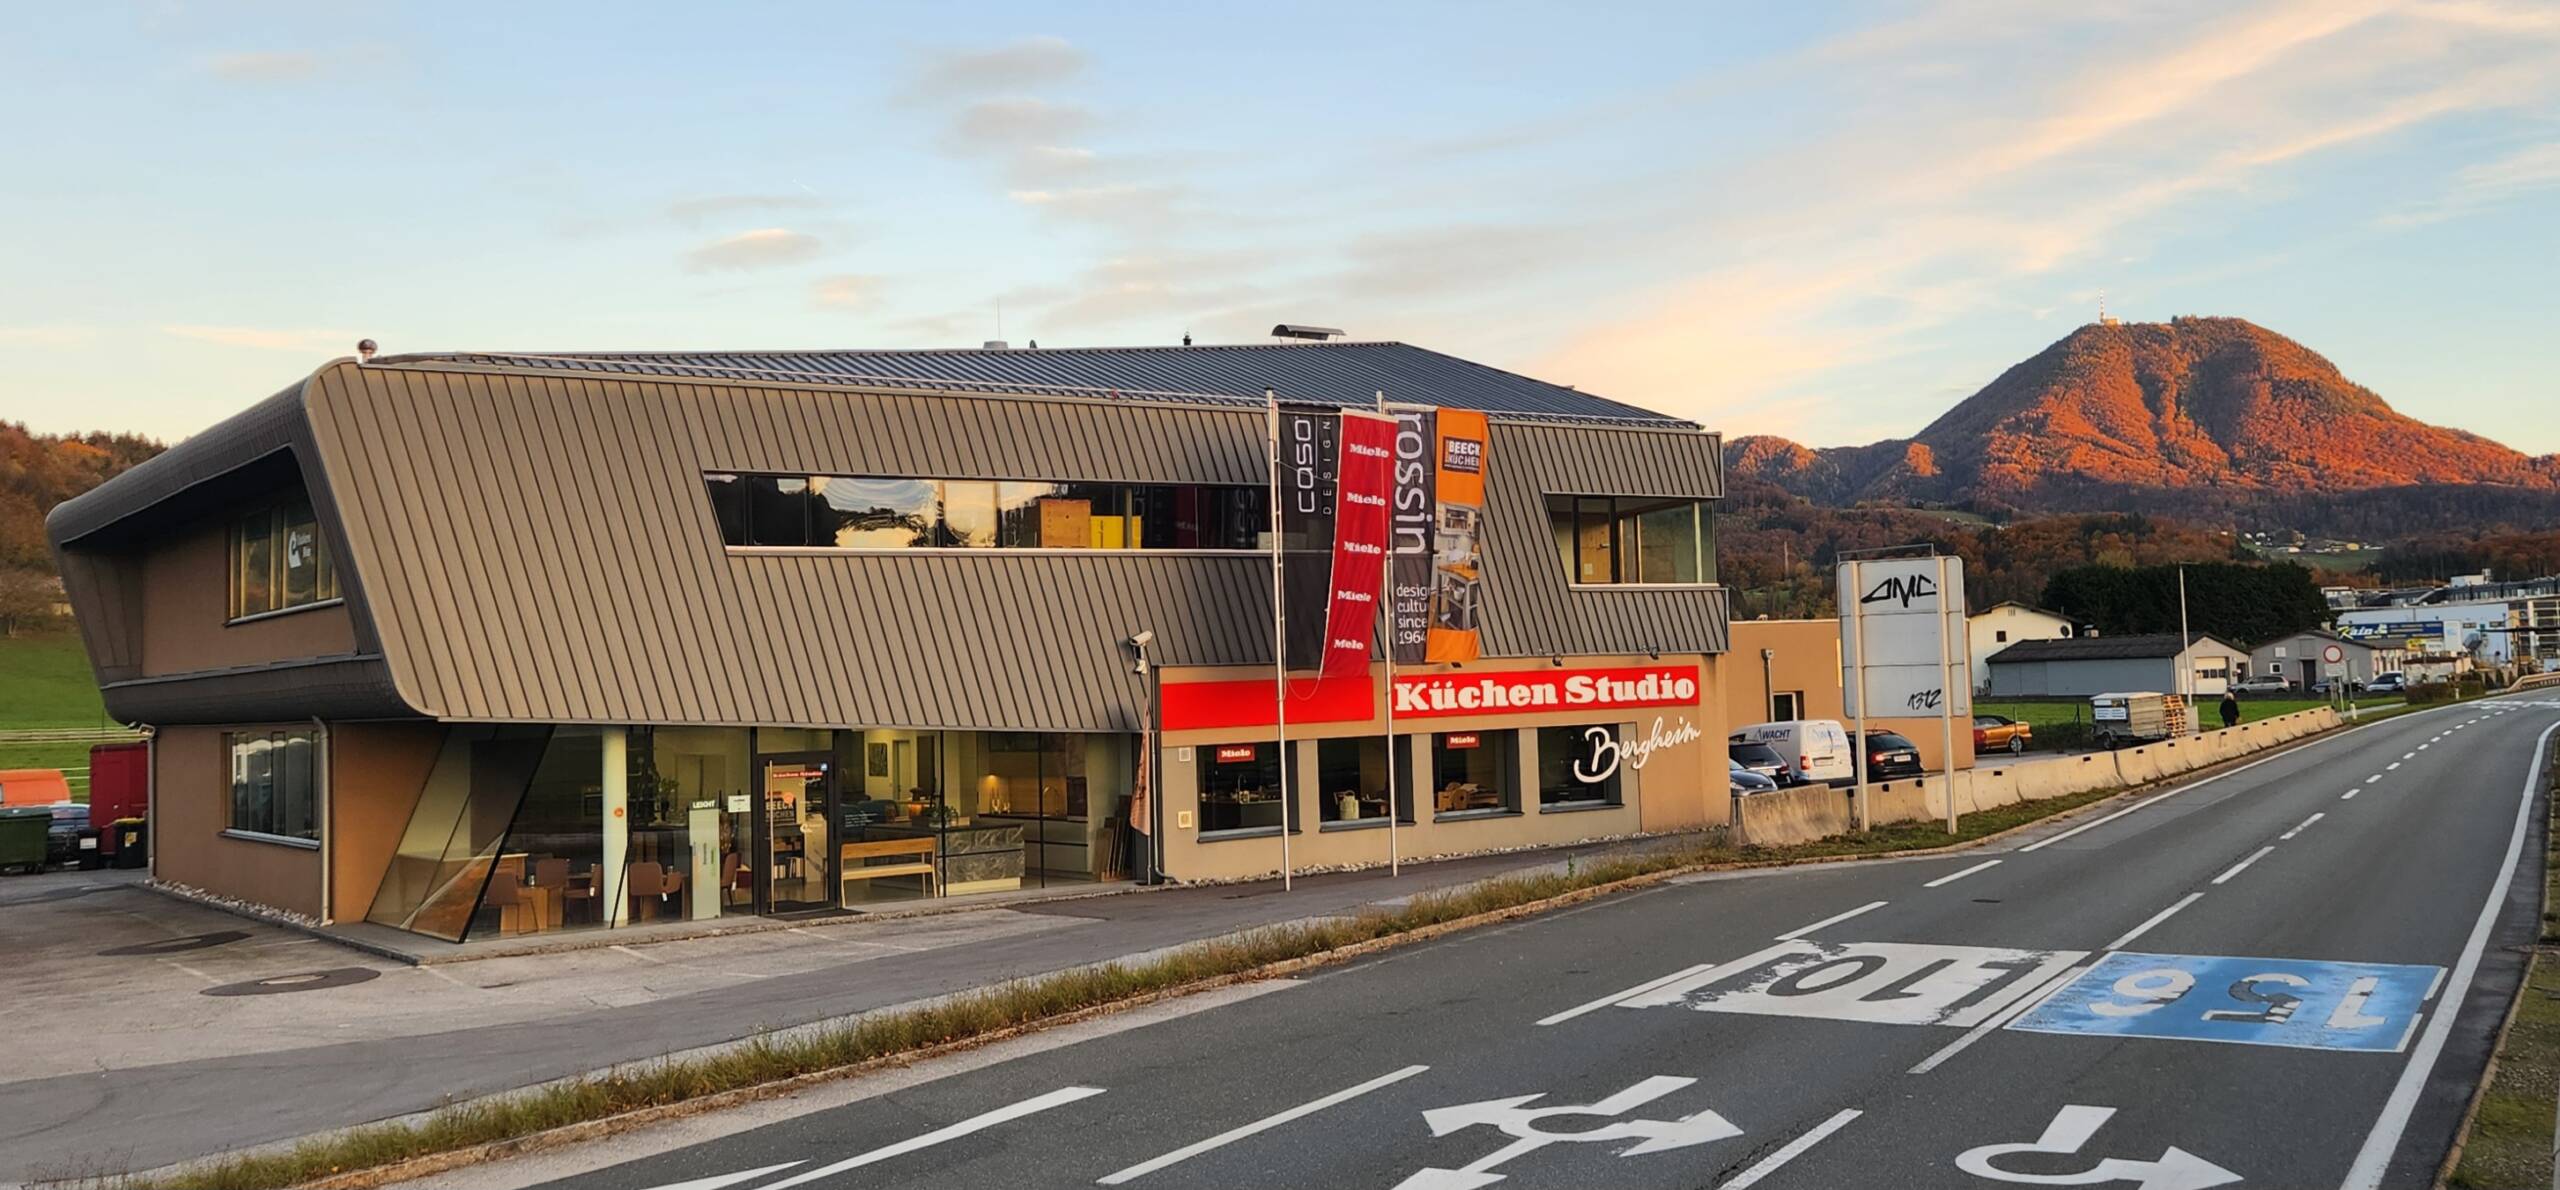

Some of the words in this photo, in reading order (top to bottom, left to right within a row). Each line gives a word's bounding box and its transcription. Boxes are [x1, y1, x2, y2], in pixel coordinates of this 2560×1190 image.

[1294, 416, 1316, 513] caso
[1350, 443, 1389, 458] Miele
[1322, 420, 1333, 516] DESIGN
[1394, 412, 1433, 554] rossin
[1347, 492, 1386, 506] Miele
[1344, 541, 1381, 555] Miele
[1398, 614, 1428, 629] since
[1399, 630, 1426, 645] 1964
[1394, 679, 1559, 711] Küchen
[1565, 672, 1696, 704] Studio
[1907, 688, 1942, 710] 1312
[1573, 716, 1702, 784] Bergheim
[2088, 967, 2388, 1030] 156
